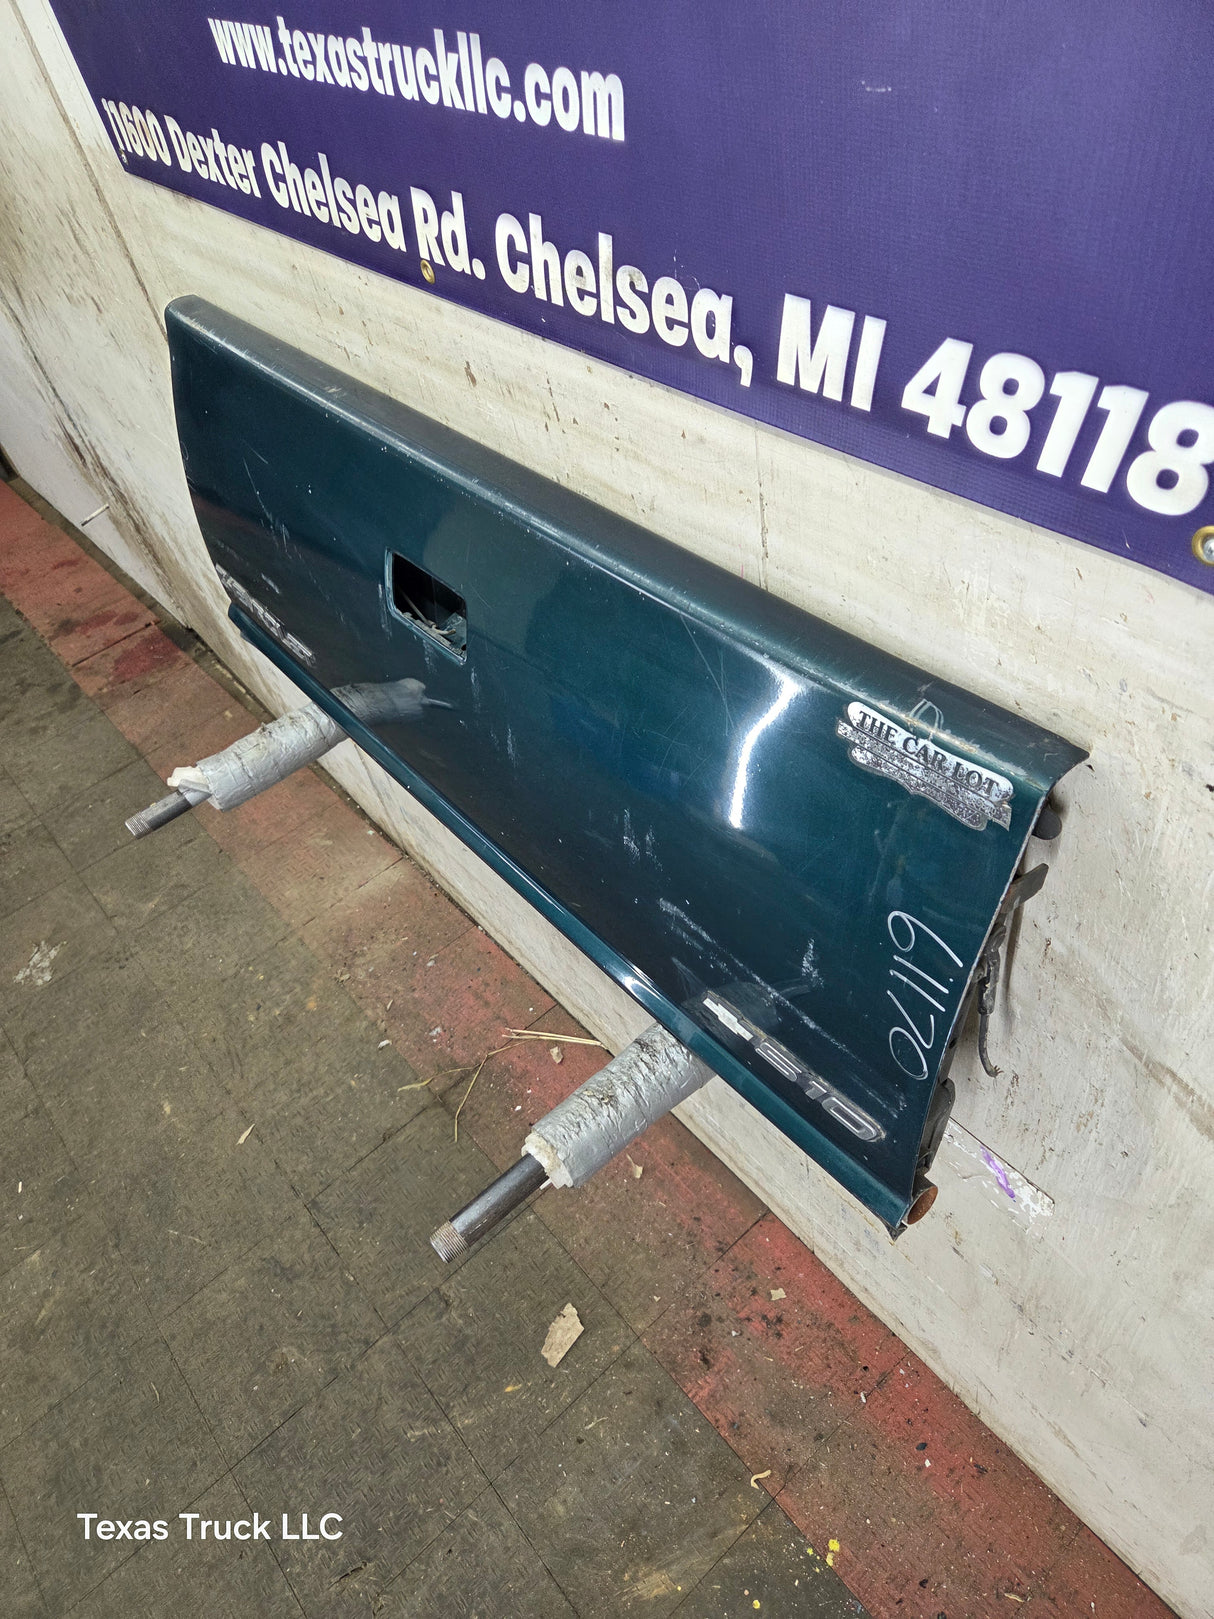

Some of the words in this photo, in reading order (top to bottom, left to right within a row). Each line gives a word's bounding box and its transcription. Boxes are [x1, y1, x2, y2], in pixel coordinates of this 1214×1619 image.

[208, 15, 625, 142] www.texastruckllc.com
[102, 97, 172, 168] 11600
[171, 114, 263, 198] Dexter
[260, 140, 406, 251] Chelsea
[409, 185, 486, 280] Rd.
[495, 211, 754, 387] Chelsea,
[776, 292, 888, 413] MI
[900, 337, 1214, 517] 48118
[858, 710, 898, 744] THE
[902, 736, 948, 772] CAR
[951, 761, 1000, 796] LOT
